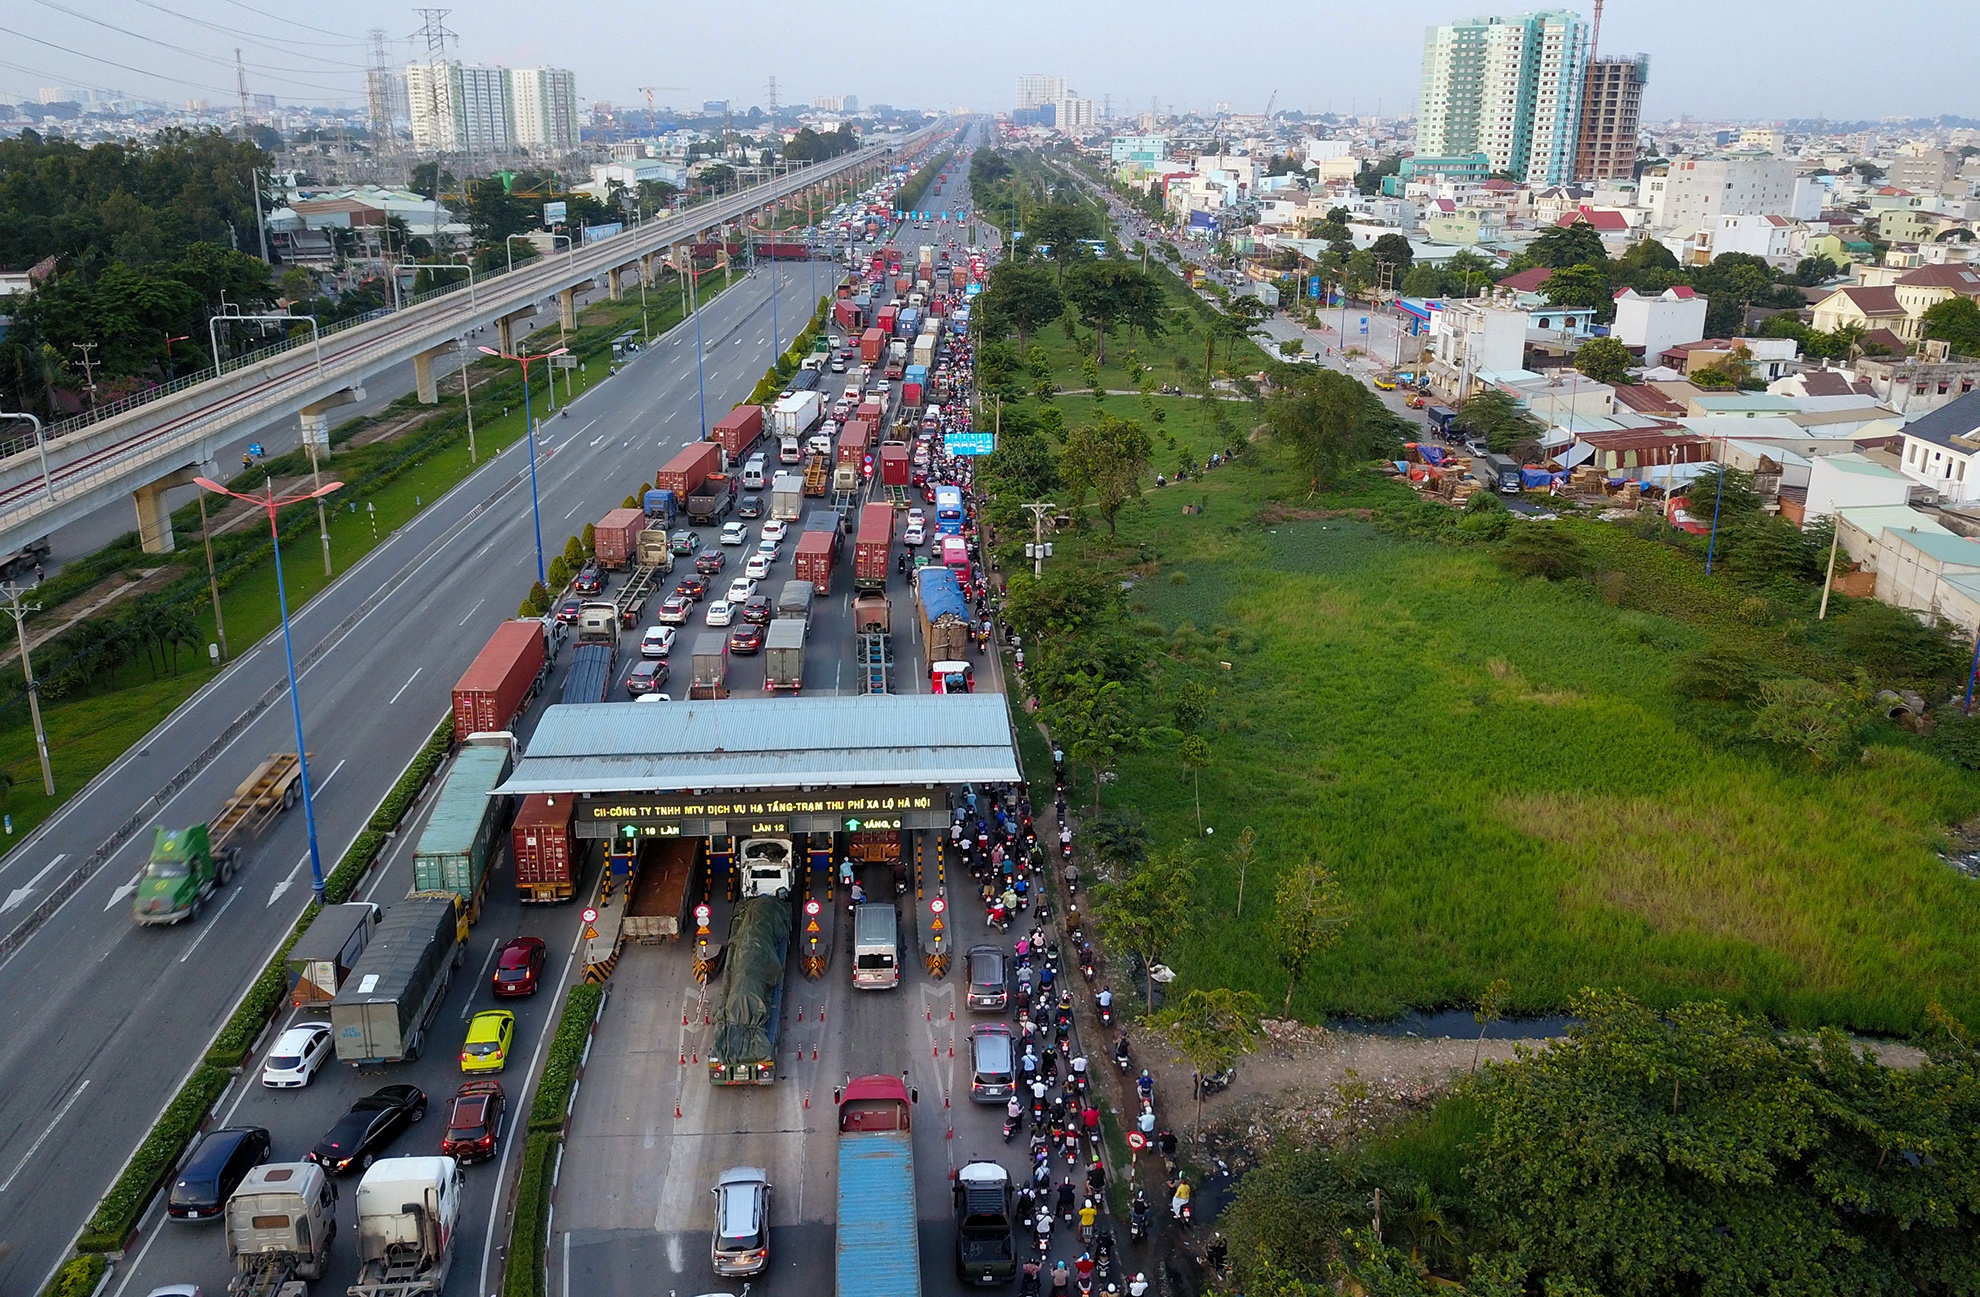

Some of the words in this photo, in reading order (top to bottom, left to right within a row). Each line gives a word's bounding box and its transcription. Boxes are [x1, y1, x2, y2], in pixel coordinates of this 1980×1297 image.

[593, 805, 637, 817] CII-CÔNG
[639, 806, 652, 816] TY
[655, 806, 681, 816] TNHH
[684, 805, 704, 815] MTV
[708, 804, 730, 816] DỊCH
[733, 804, 747, 814] VỤ
[750, 803, 763, 813] HẠ
[826, 800, 844, 811] THU
[848, 798, 864, 810] PHÍ
[866, 799, 879, 809] XA
[882, 797, 894, 810] LỘ
[914, 796, 930, 809] NỘI
[752, 822, 772, 832] LÀN
[774, 824, 785, 832] 12
